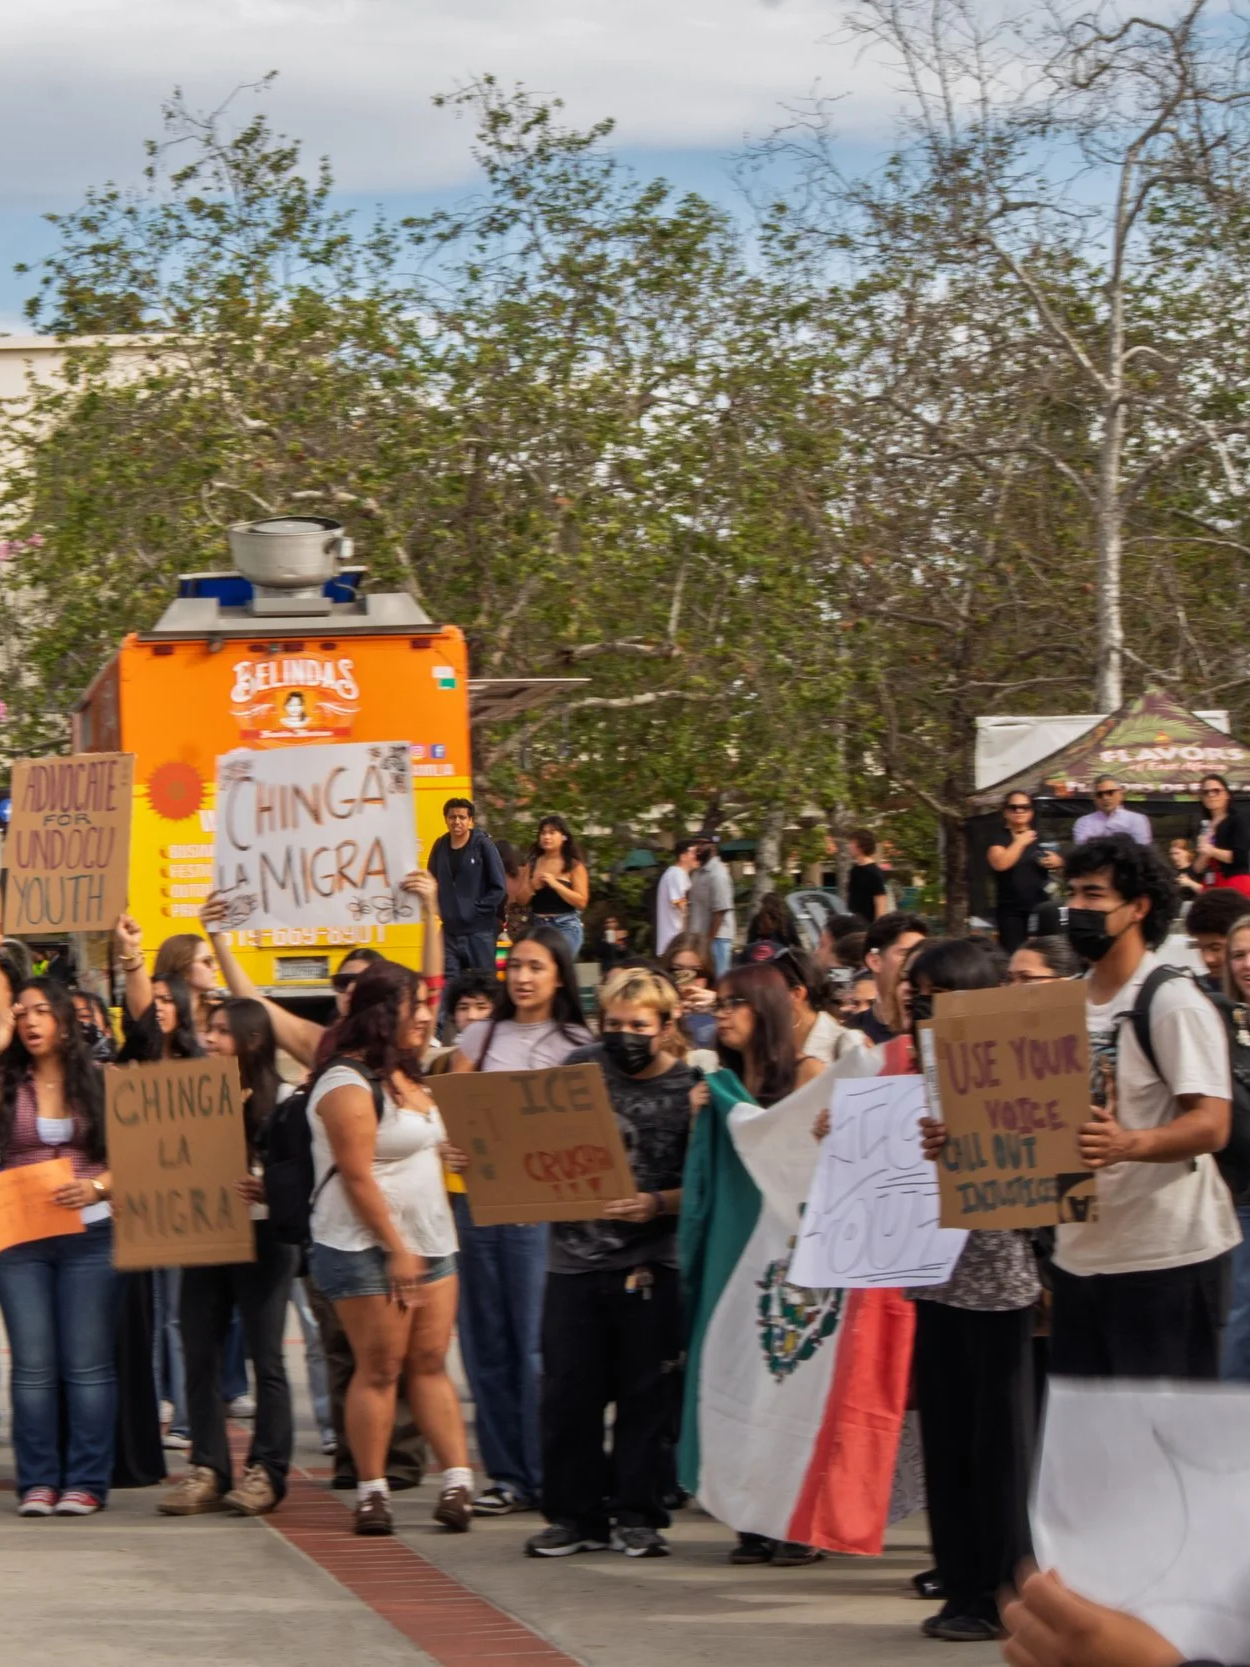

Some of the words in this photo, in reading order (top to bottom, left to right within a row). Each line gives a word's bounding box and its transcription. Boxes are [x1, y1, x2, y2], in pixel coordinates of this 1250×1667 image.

[230, 658, 360, 703] BELINDAS
[1099, 746, 1246, 762] FLAVORS
[21, 760, 118, 812] ADVOCATE
[225, 765, 387, 851] CHINGA
[43, 813, 92, 826] FOR
[16, 827, 116, 870] UNDOCU
[259, 836, 391, 914] MIGRA
[12, 874, 106, 927] YOUTH
[945, 1040, 1002, 1096] USE
[1009, 1034, 1085, 1081] YOUR
[112, 1073, 234, 1127] CHINGA
[510, 1071, 593, 1115] ICE
[984, 1096, 1068, 1134] VOICE
[159, 1134, 192, 1169] LA
[125, 1186, 237, 1243] MIGRA
